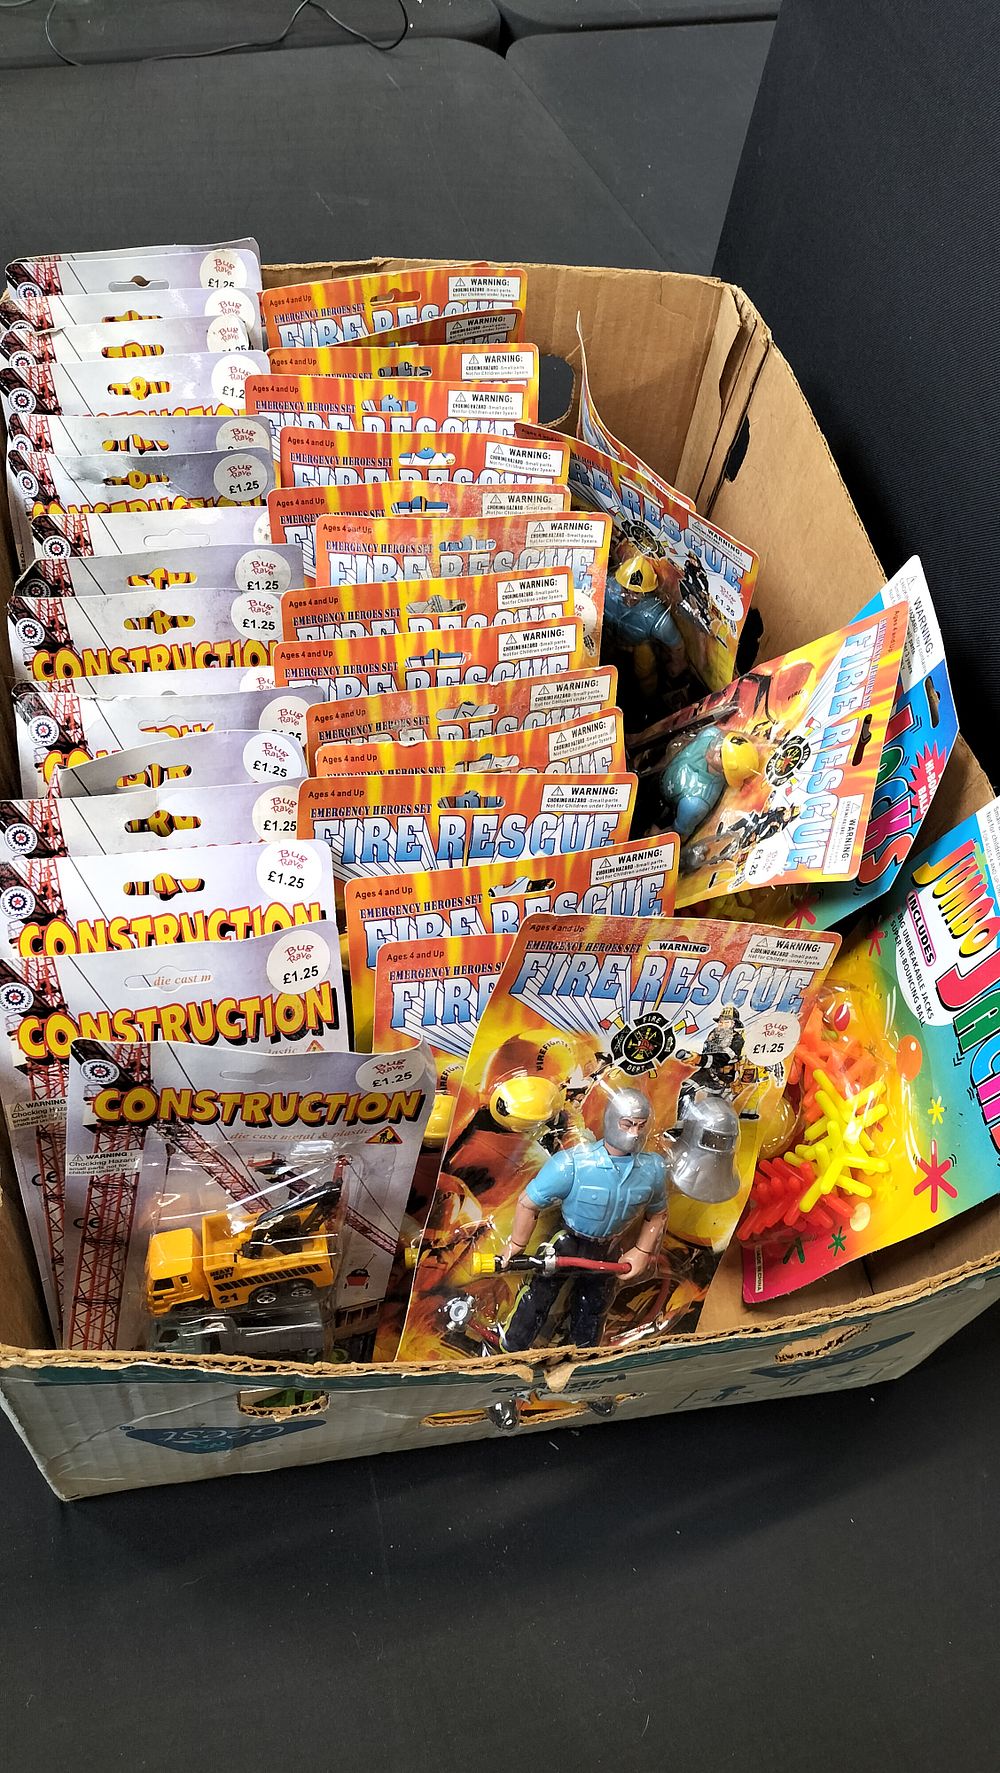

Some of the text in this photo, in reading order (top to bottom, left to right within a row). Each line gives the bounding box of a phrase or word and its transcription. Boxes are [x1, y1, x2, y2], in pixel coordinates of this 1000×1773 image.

[208, 278, 235, 288] £125
[471, 278, 510, 286] WARNING:
[274, 303, 365, 323] EMERGENCY HEROES SET
[485, 355, 523, 363] WARNING:
[222, 385, 245, 399] £1.2
[253, 385, 269, 393] Ages
[290, 386, 299, 394] Up
[472, 394, 513, 403] WARNING:
[290, 453, 392, 466] EMERGENCY HEROES SET
[509, 448, 551, 460] WARNING:
[229, 480, 259, 494] £1.25
[551, 523, 593, 531] WARNING:
[621, 484, 744, 593] RESCUE
[326, 541, 433, 553] EMERGENCY HEROES SET
[329, 552, 427, 587] FIRE
[247, 580, 279, 590] £1.25
[520, 579, 558, 590] WARNING:
[289, 600, 306, 608] Ages
[329, 597, 338, 605] Up
[242, 618, 275, 630] £1.25
[523, 629, 565, 642] WARNING:
[32, 638, 278, 681] CONSTRUCTIO
[285, 661, 398, 678] EMERGENCY HEROES SET
[556, 679, 600, 692] WARNING:
[572, 721, 607, 738] WARNING:
[784, 623, 879, 871] FIRE RESCUE
[253, 760, 288, 778] £1.25
[308, 791, 329, 800] Ages
[353, 789, 365, 798] Up
[571, 787, 618, 795] WARNING:
[263, 820, 297, 832] £1.25
[314, 813, 618, 864] FIRE RESCUE
[618, 849, 663, 864] WARNING:
[268, 870, 305, 889] £1.25
[355, 890, 376, 899] Ages
[385, 888, 400, 896] and
[402, 886, 413, 896] Up
[912, 839, 1000, 958] JUMBO
[360, 894, 483, 919] EMERGENCY HEROES SET
[908, 895, 934, 963] INCLUDES
[526, 941, 642, 953] EMERGENCY HEROES SET
[776, 940, 821, 953] WARNING:
[283, 965, 319, 985] £1.25
[389, 964, 492, 981] EMERGENCY HEROES
[890, 920, 927, 1028] SUPER HI-BOUNCING BALL
[902, 928, 925, 990] UNBREAKABLE
[921, 991, 935, 1020] JACKS
[154, 975, 197, 987] die cast
[510, 952, 814, 1014] FIRE RESCUE
[391, 974, 500, 1028] FIRE
[18, 981, 335, 1058] CONSTRUCTION
[752, 1042, 785, 1054] £1.25
[372, 1071, 413, 1087] £1.25
[94, 1086, 423, 1124] CONSTRUCTION
[252, 1132, 277, 1140] cast
[332, 1128, 372, 1138] plastic
[219, 1293, 239, 1304] 21
